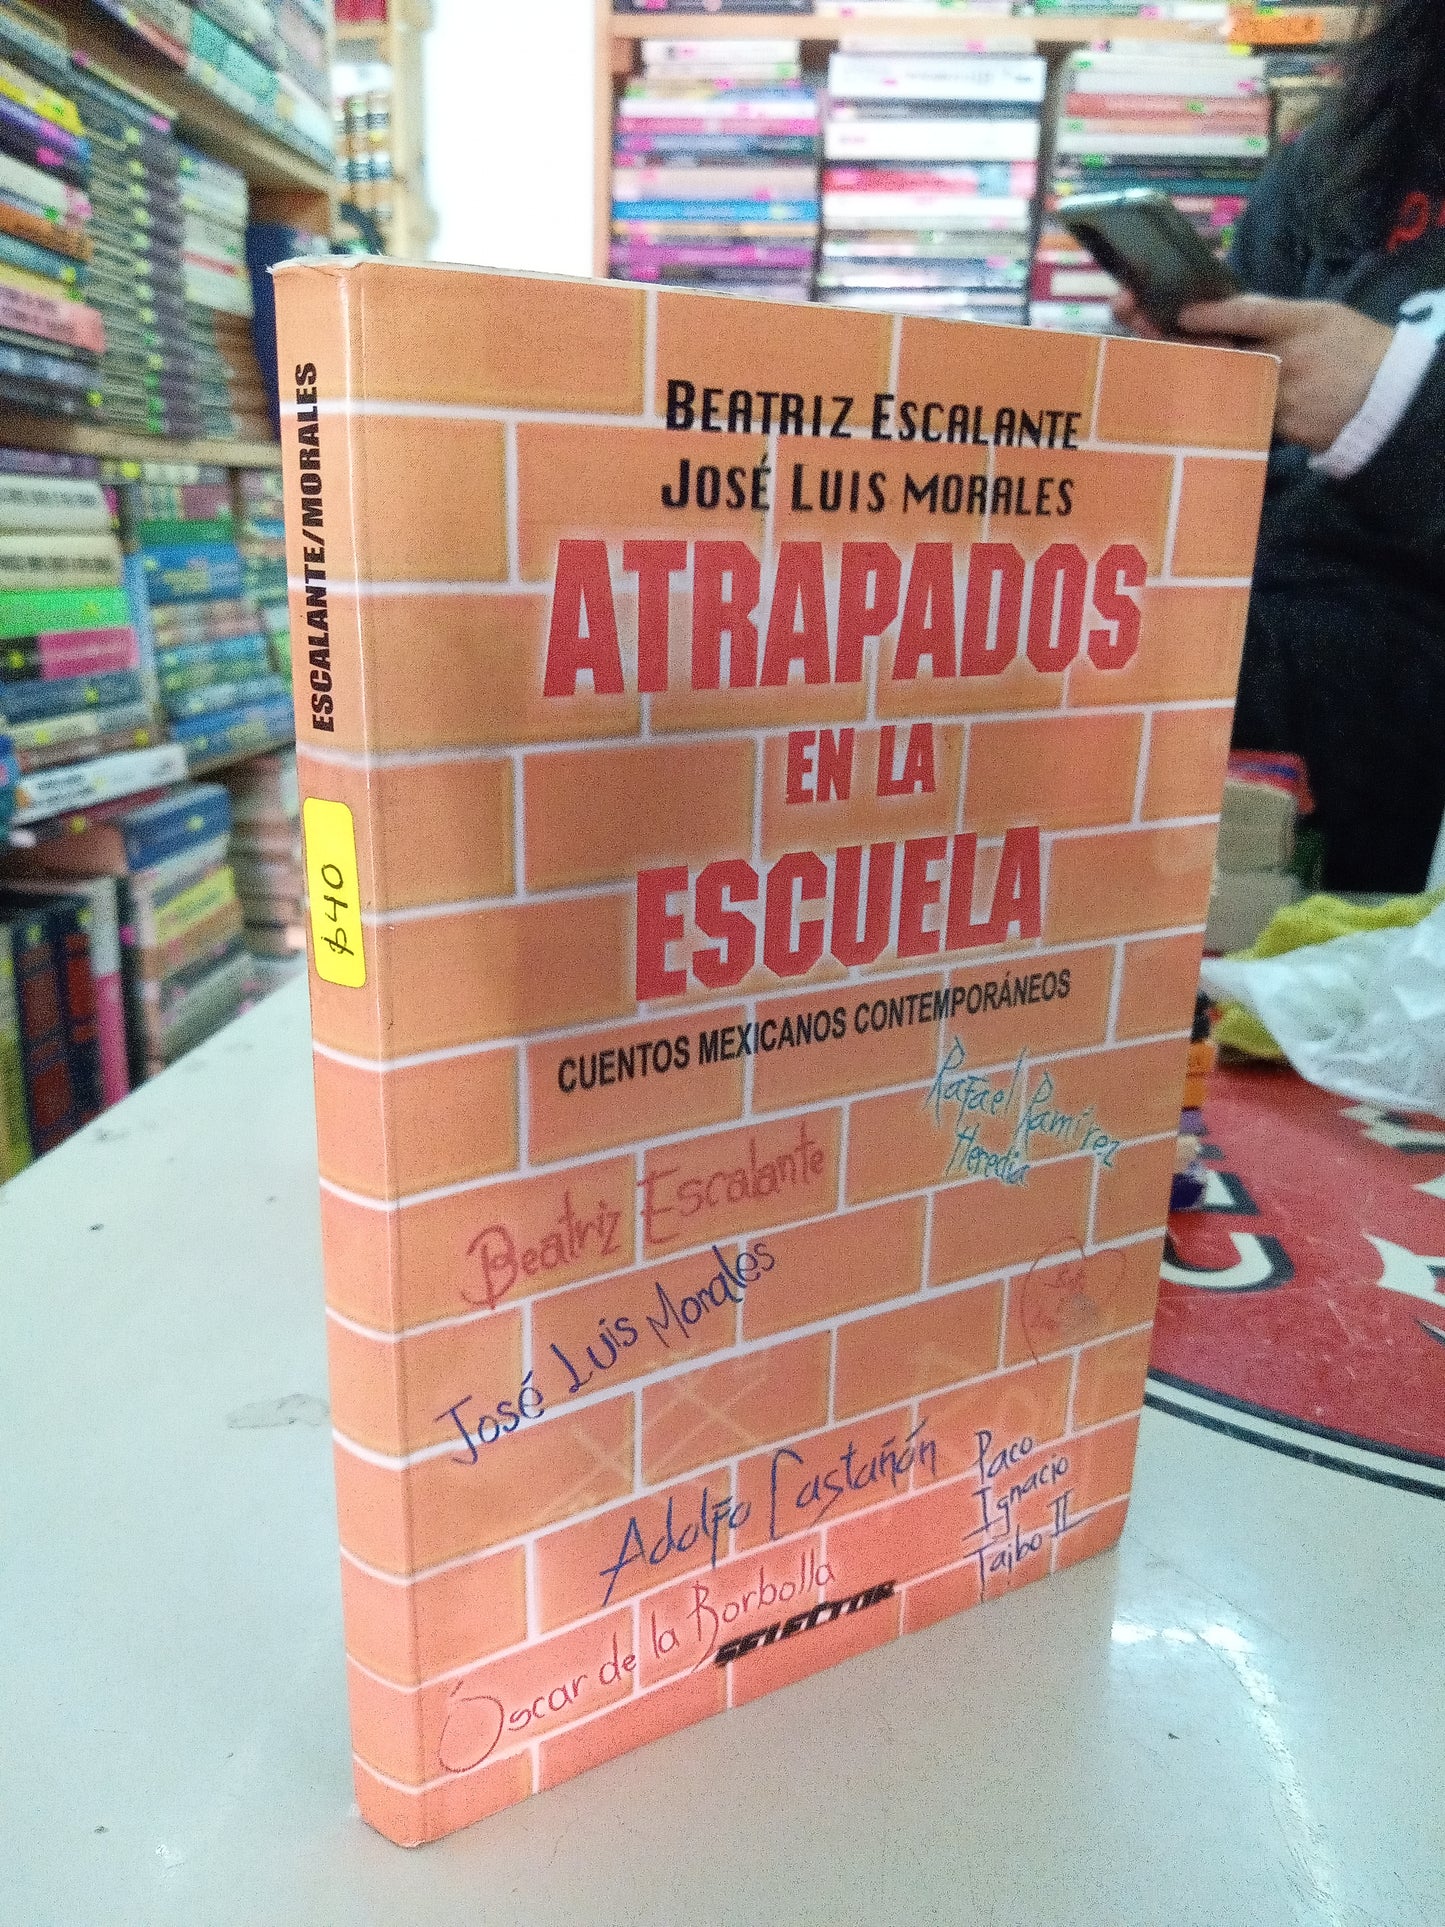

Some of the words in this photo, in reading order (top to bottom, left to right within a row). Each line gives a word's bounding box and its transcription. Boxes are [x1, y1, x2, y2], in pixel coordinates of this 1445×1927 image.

[667, 379, 853, 438] BEATRIZ
[872, 394, 1081, 450] ESCALANTE
[661, 454, 771, 510] JOSÉ
[792, 463, 887, 513] LUIS
[903, 472, 1074, 516] MORALES
[296, 362, 334, 732] ESCALANTE/MORALES
[544, 539, 1148, 697] ATRAPADOS
[786, 728, 854, 805] EN
[877, 723, 936, 797] LA
[321, 864, 355, 956] $40
[636, 826, 1041, 1000] ESCUELA
[558, 1036, 690, 1093] CUENTOS
[698, 1003, 846, 1065] MEXICANOS
[854, 969, 1072, 1033] CONTEMPORÁNEOS
[925, 1035, 1028, 1128] Rafael
[459, 1189, 621, 1309] Beatriz
[637, 1121, 824, 1244] Escalante
[435, 1370, 544, 1465] José
[550, 1314, 639, 1393] Luis
[646, 1243, 775, 1347] Morales
[600, 1488, 751, 1606] Adolfo
[769, 1417, 937, 1541] Castañón
[962, 1457, 1068, 1541] Ignacio
[973, 1430, 1034, 1484] Paco
[963, 1524, 1042, 1603] Taibo
[1047, 1488, 1096, 1538] II
[438, 1680, 588, 1772] Óscar
[599, 1640, 637, 1686] de
[652, 1611, 679, 1658] la
[690, 1548, 837, 1672] Borbolla
[711, 1579, 897, 1669] SELECTOR
